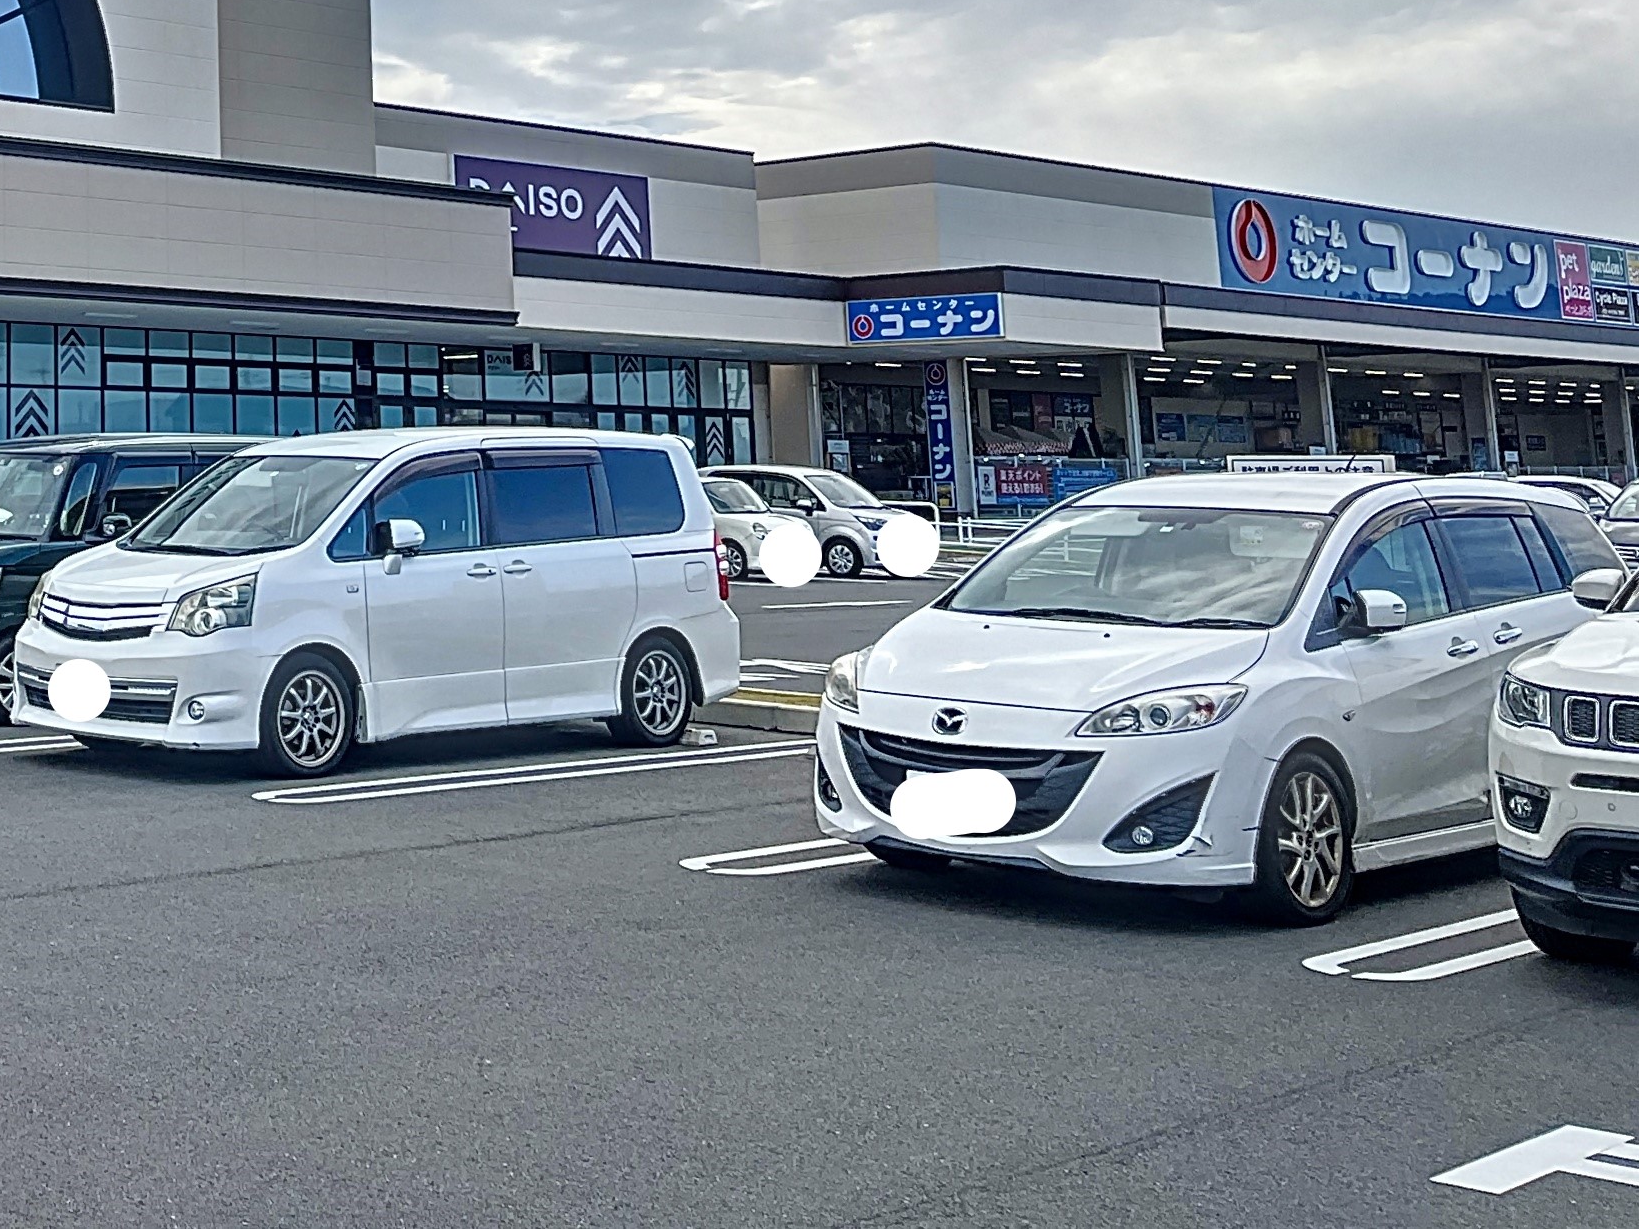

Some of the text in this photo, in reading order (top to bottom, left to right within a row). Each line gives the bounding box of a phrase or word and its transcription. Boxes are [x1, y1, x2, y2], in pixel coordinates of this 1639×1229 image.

[1290, 214, 1348, 249] ホーム
[1289, 248, 1358, 283] センター
[1360, 219, 1548, 309] コーナン
[1558, 248, 1580, 279] pet
[869, 298, 975, 313] ホームセンター
[1563, 278, 1592, 304] plaza
[880, 309, 995, 337] コーナン
[486, 354, 512, 365] DAIS
[930, 404, 952, 480] コーナン
